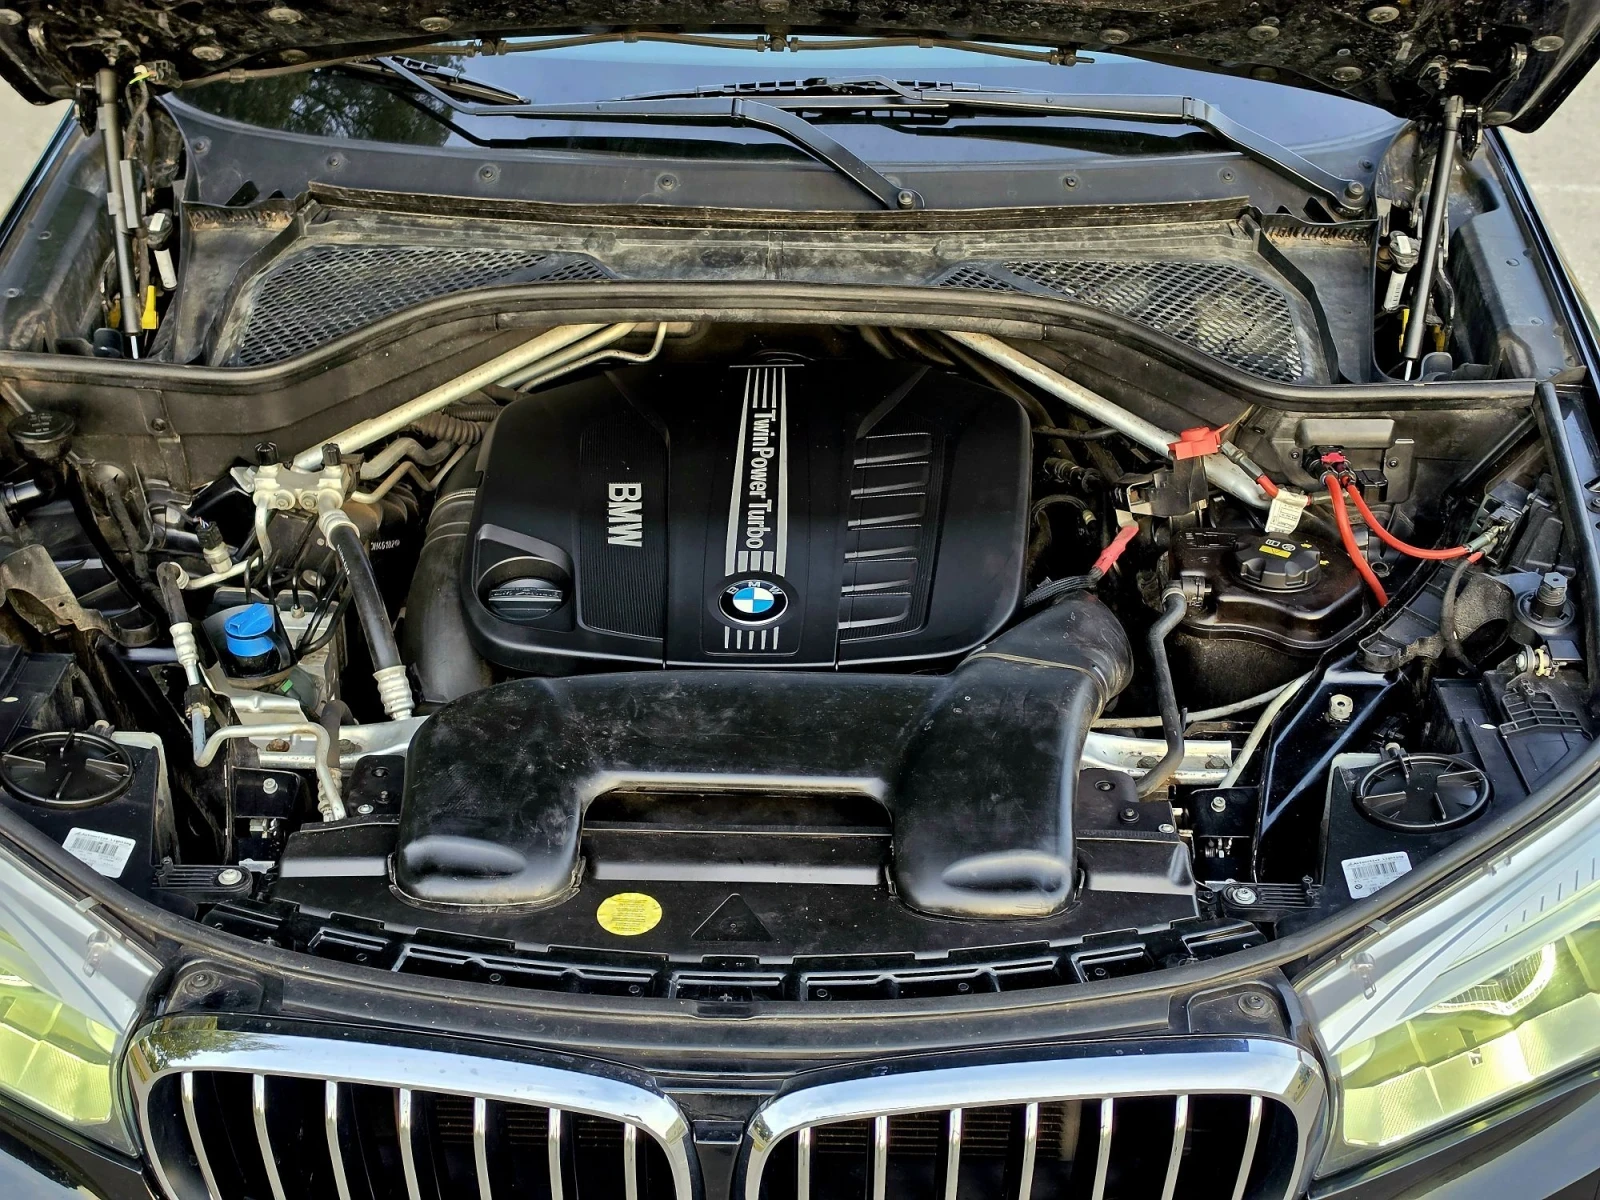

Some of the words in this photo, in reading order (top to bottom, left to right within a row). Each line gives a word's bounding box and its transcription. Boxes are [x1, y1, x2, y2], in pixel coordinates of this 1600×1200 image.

[749, 409, 776, 499] TwinPower
[608, 482, 643, 548] BMW
[745, 499, 772, 549] Turbo
[726, 581, 783, 595] BMW
